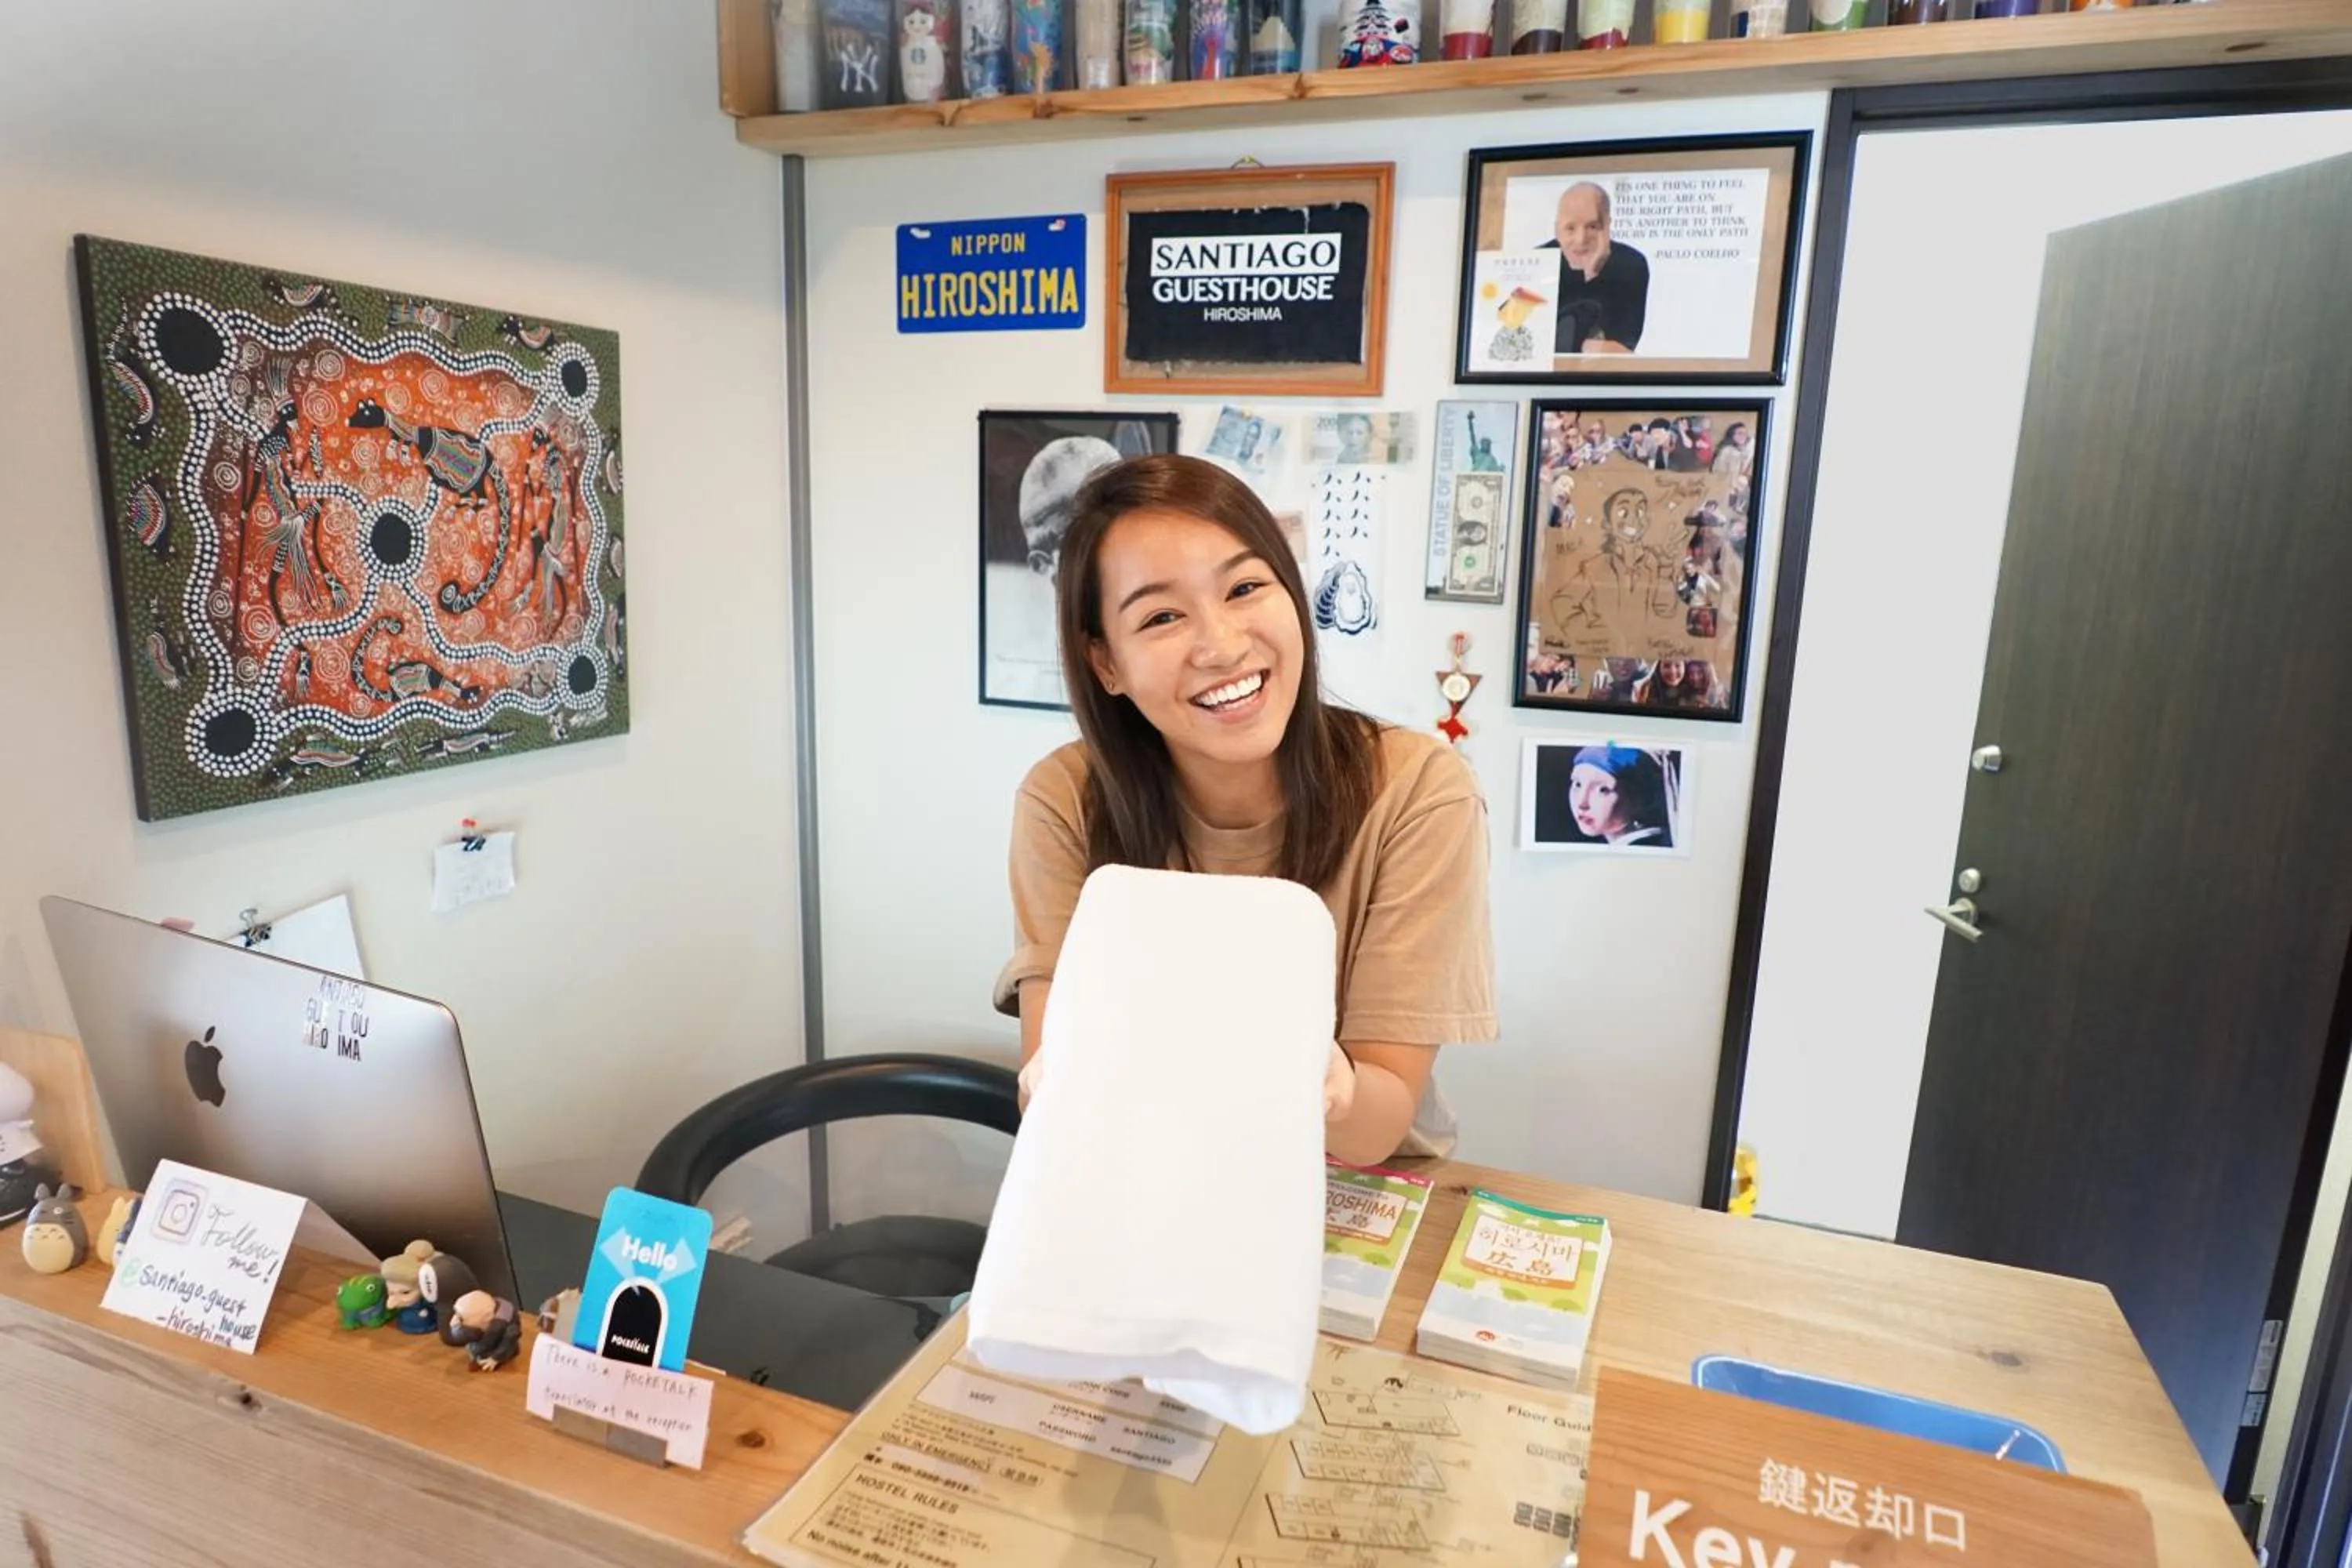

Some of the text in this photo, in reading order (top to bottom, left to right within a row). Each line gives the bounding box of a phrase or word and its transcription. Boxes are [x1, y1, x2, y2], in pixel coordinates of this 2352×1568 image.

[951, 233, 1025, 256] NIPPON
[1156, 240, 1336, 270] SANTIAGO
[901, 267, 1079, 318] HIROSHIMA
[1152, 276, 1334, 303] GUESTHOUSE
[1203, 307, 1282, 321] HIROSHIMA
[1434, 406, 1458, 557] STATUE OF LIBERTY
[201, 1203, 278, 1259] Follow
[622, 1235, 677, 1270] Hello
[1507, 1404, 1548, 1425] Floor
[855, 1473, 909, 1499] HOSTEL
[912, 1491, 960, 1515] RULES
[1758, 1457, 1966, 1552] 鍵返却口
